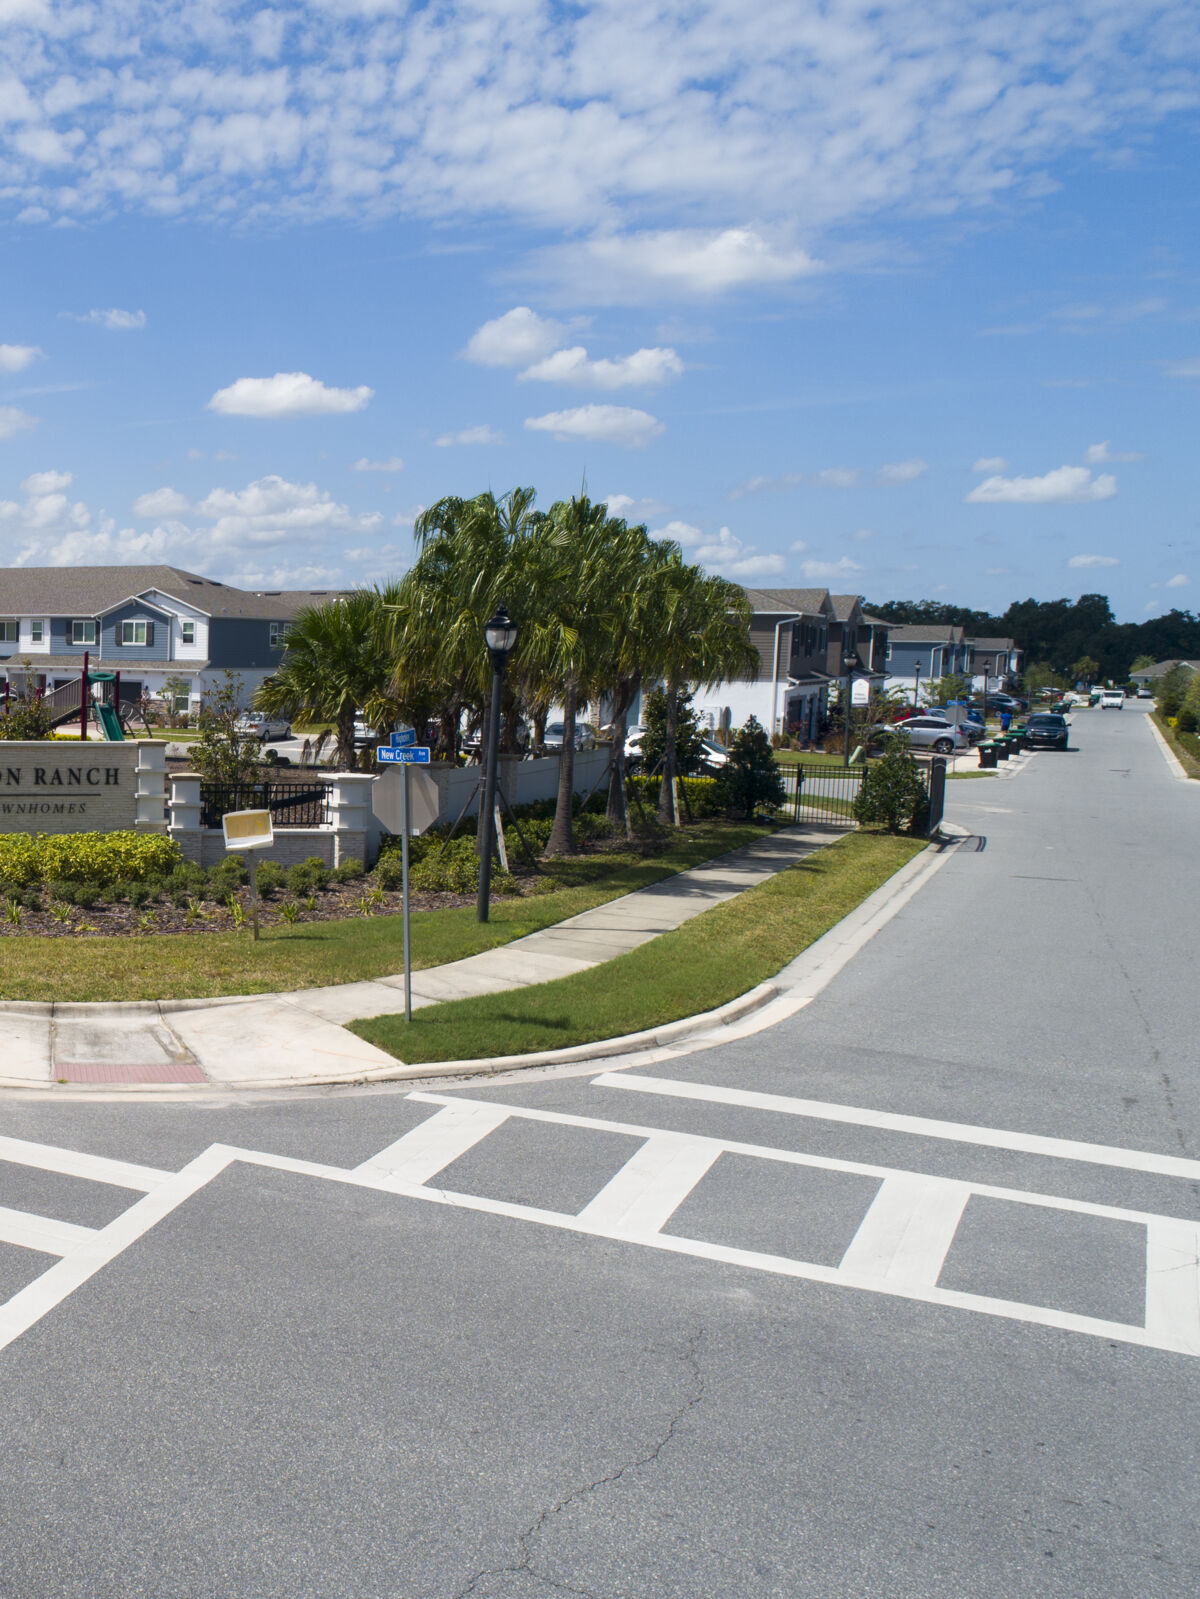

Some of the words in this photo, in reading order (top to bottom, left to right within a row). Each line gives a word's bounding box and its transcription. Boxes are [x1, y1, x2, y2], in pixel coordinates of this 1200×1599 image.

[381, 749, 394, 760] New
[395, 749, 414, 760] Creek
[33, 767, 121, 786] RANCH
